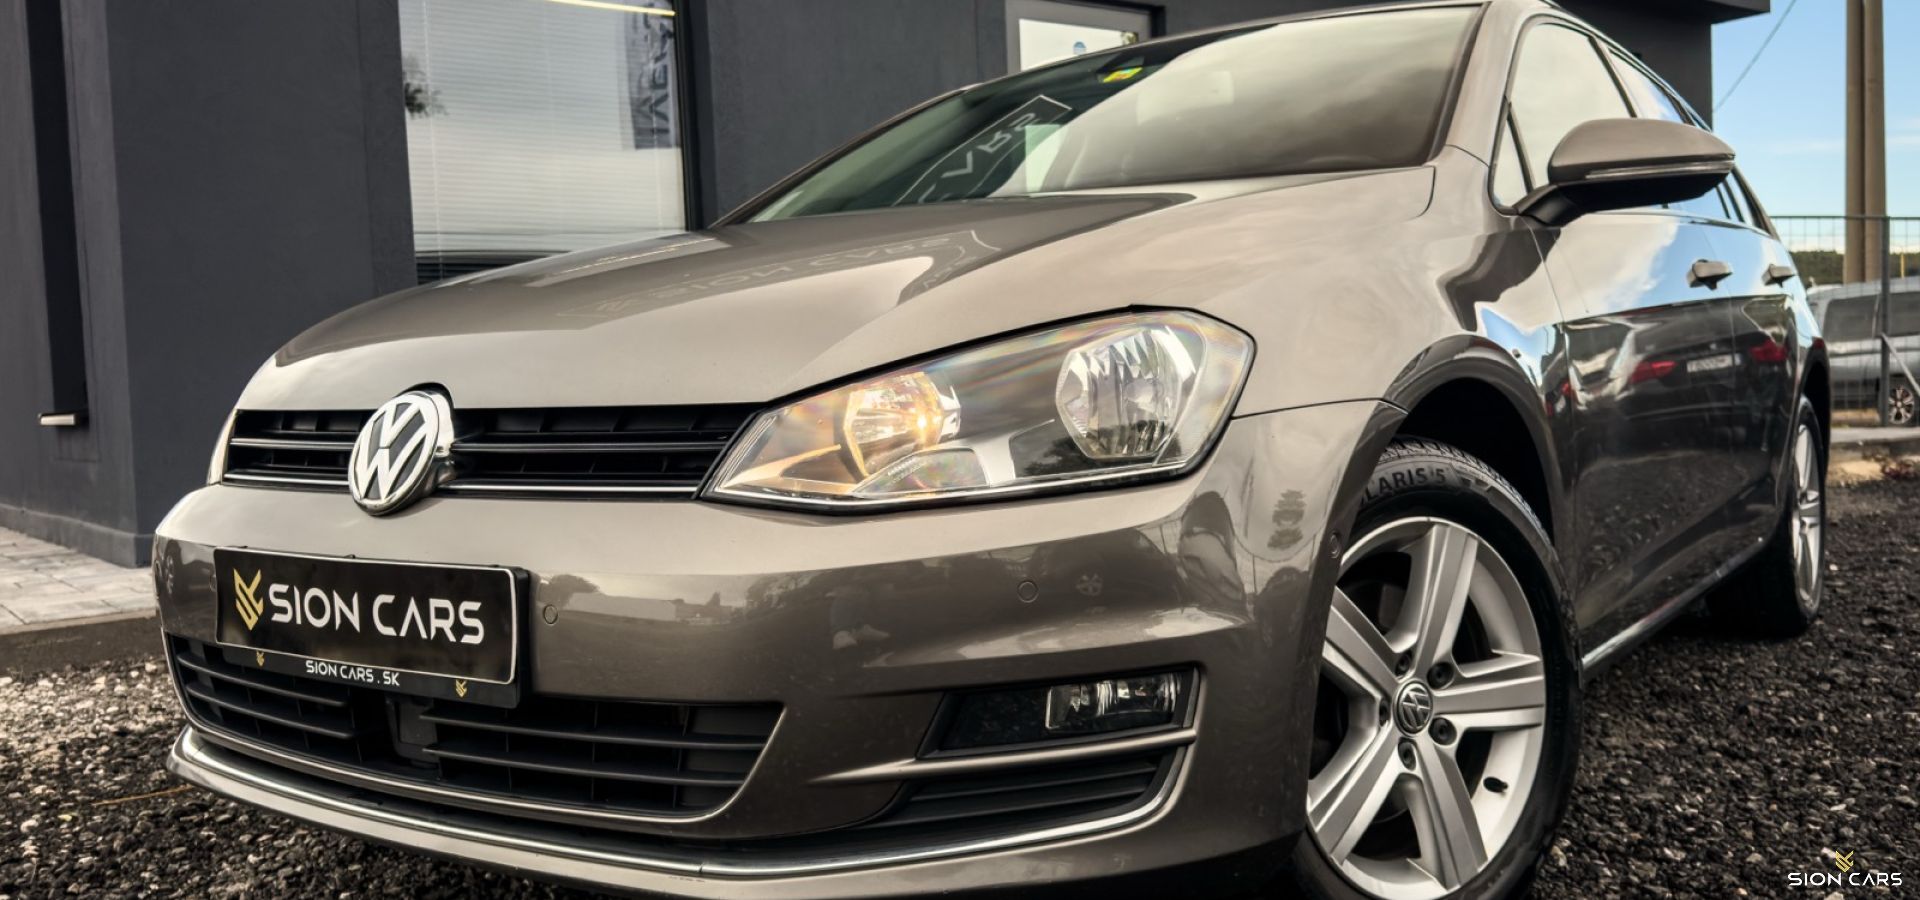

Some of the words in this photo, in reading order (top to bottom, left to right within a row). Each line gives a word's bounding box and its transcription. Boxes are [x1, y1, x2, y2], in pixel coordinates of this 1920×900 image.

[1360, 467, 1426, 504] LARIS
[269, 583, 360, 633] SION
[373, 594, 485, 645] CARS
[306, 660, 337, 677] SION
